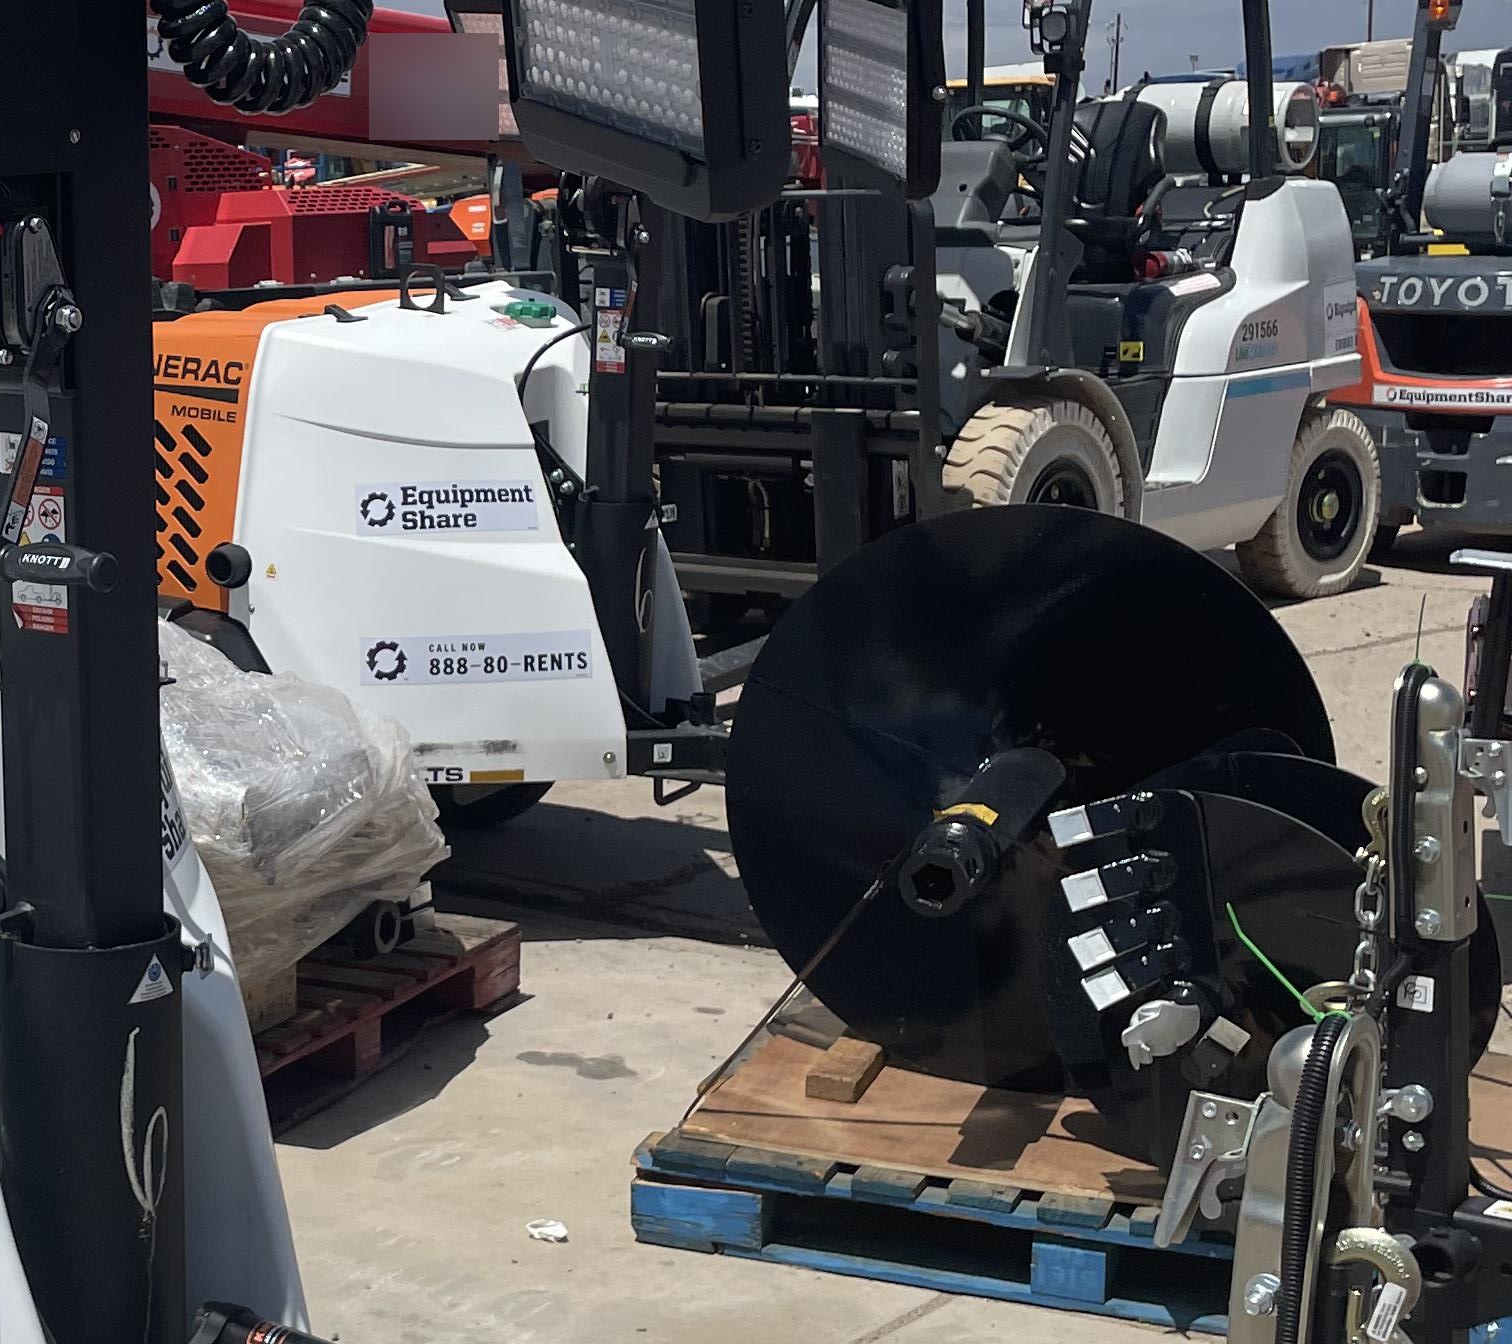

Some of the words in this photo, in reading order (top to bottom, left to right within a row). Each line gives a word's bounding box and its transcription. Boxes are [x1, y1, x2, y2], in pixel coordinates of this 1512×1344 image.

[1380, 275, 1512, 307] TOYOT
[1241, 319, 1279, 342] 291566
[1399, 389, 1512, 404] EquipmentShar
[171, 404, 237, 423] MOBILE
[400, 484, 534, 509] Equipment
[401, 500, 478, 530] Share
[22, 554, 61, 565] KNOTT
[428, 643, 456, 653] CALL
[462, 642, 486, 652] NOW
[429, 652, 588, 675] 888-80-RENTS
[426, 767, 464, 782] TS
